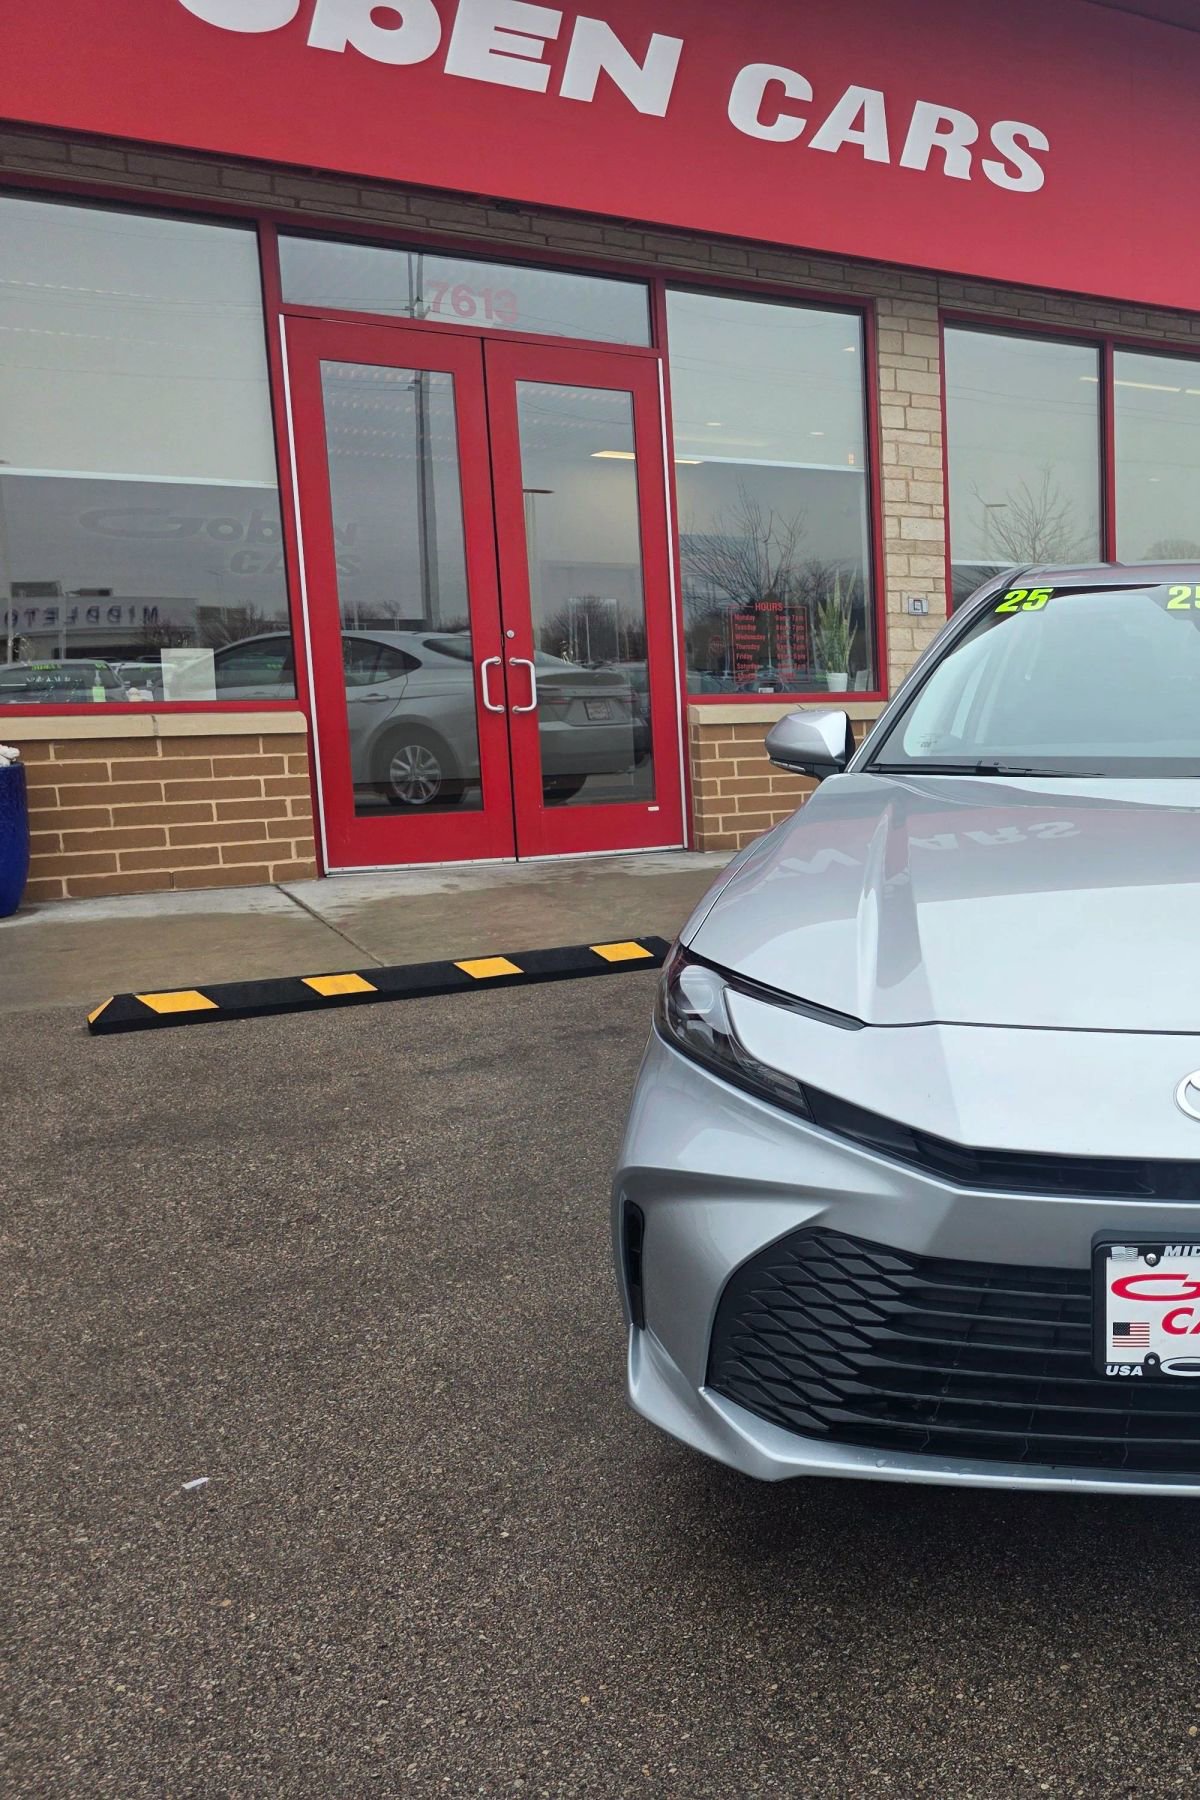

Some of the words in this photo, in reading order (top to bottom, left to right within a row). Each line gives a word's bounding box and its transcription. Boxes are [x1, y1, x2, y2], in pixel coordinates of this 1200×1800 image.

[727, 63, 1050, 193] CARS
[425, 279, 518, 323] 7613
[754, 602, 783, 611] HOURS
[995, 587, 1054, 613] 25
[1105, 1364, 1143, 1377] USA
